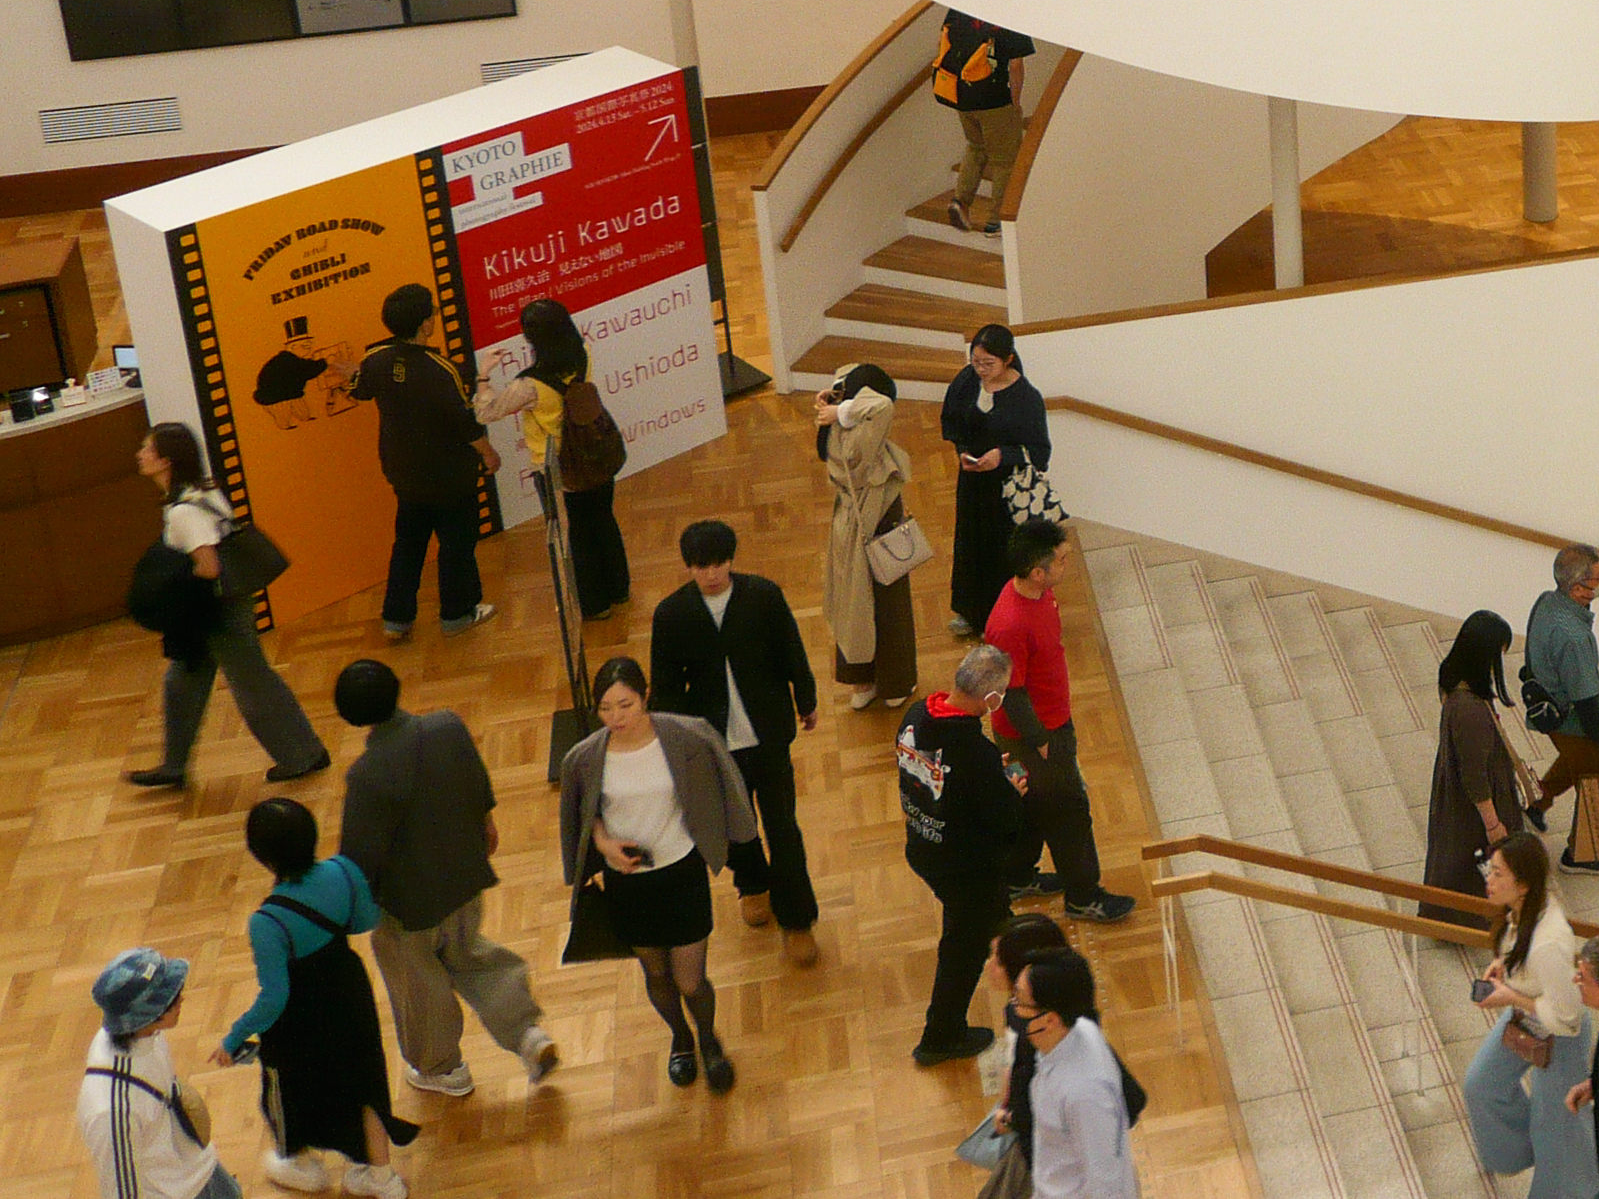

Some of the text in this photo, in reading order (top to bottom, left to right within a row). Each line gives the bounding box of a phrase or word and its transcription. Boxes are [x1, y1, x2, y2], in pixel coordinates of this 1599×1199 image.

[451, 140, 516, 174] KYOTO
[479, 151, 564, 191] GRAPHIE
[242, 217, 386, 282] FRIDAY ROAD SHOW
[483, 195, 681, 280] Kikuji Kawada
[270, 261, 372, 306] EXHIBITION
[289, 252, 347, 281] GHIBLI
[491, 303, 516, 318] The
[554, 272, 600, 295] Visions
[601, 264, 615, 279] of
[617, 257, 638, 273] the
[579, 282, 692, 343] Kawauchi
[604, 342, 700, 395] Ushioda
[621, 397, 706, 444] Windows
